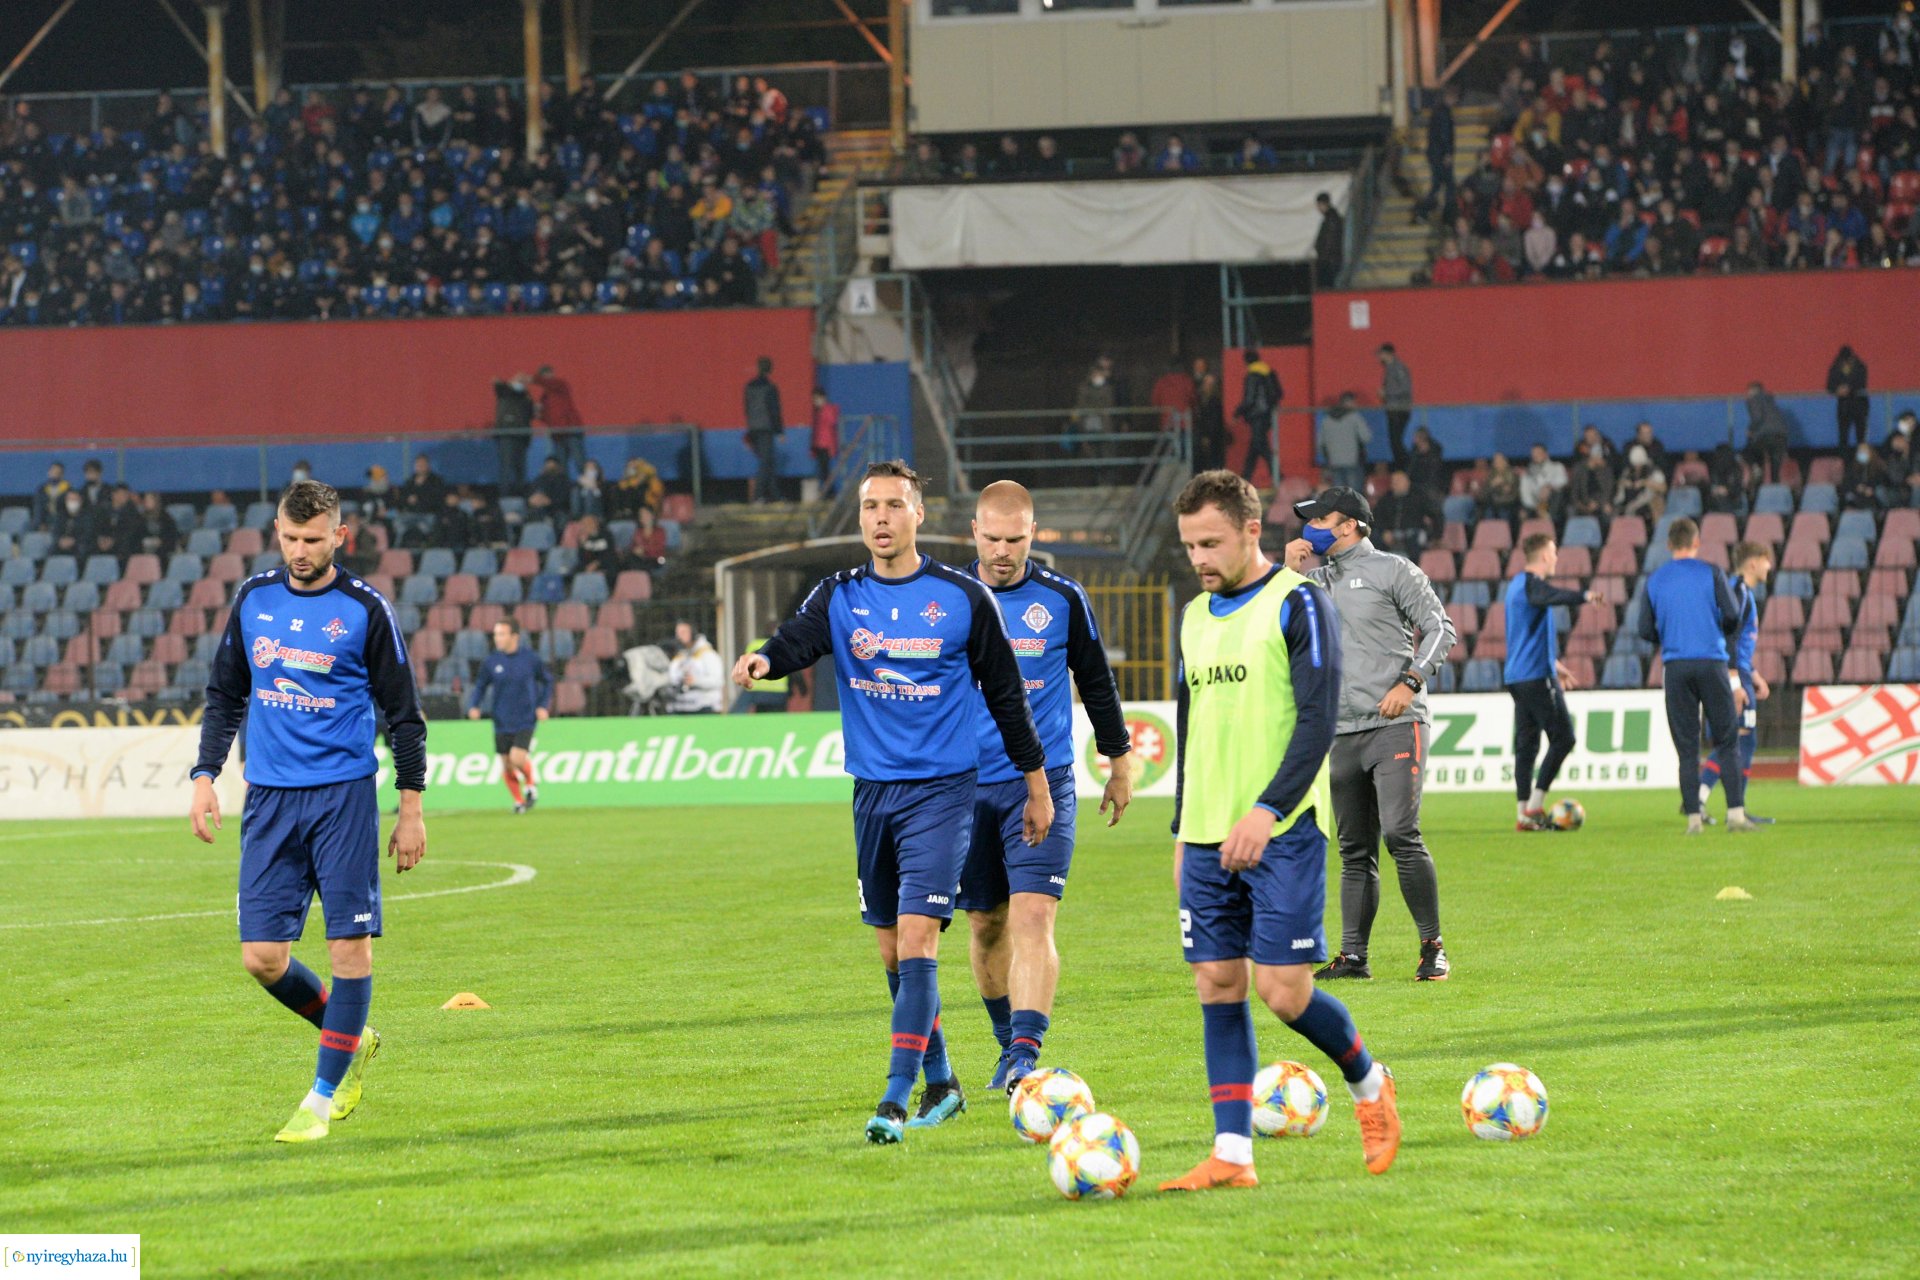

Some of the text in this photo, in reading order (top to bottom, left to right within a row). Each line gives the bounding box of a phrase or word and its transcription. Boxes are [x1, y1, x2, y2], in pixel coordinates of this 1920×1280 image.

[891, 608, 899, 620] 8
[290, 619, 304, 631] 32
[1206, 663, 1247, 685] JAKO
[897, 684, 941, 697] TRANS
[295, 696, 335, 708] TRANS
[1049, 875, 1065, 886] JAKO
[926, 894, 949, 905] JAKO
[353, 913, 372, 923] JAKO
[1291, 938, 1315, 949] JAKO
